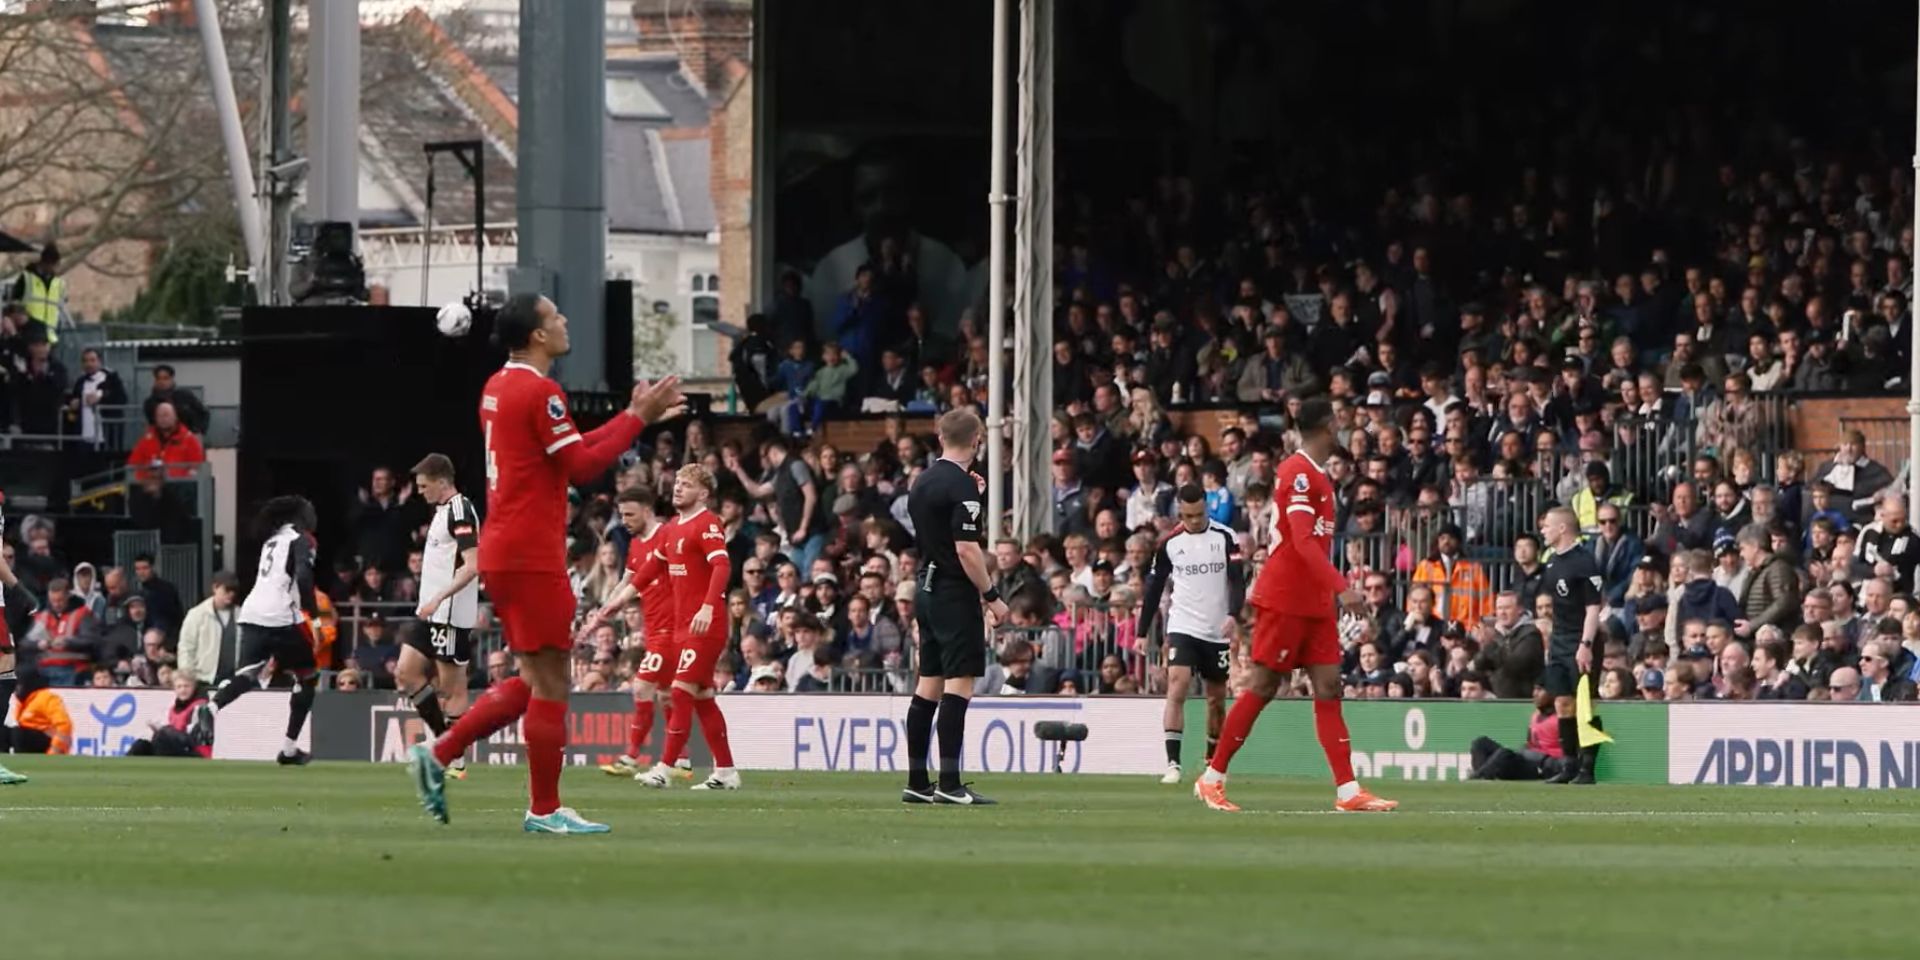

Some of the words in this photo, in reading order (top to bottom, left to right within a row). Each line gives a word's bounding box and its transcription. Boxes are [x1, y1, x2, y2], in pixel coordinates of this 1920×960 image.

[261, 541, 278, 577] 3
[430, 627, 447, 647] 26
[639, 651, 662, 671] 20
[677, 648, 696, 669] 19
[1218, 650, 1230, 669] 3
